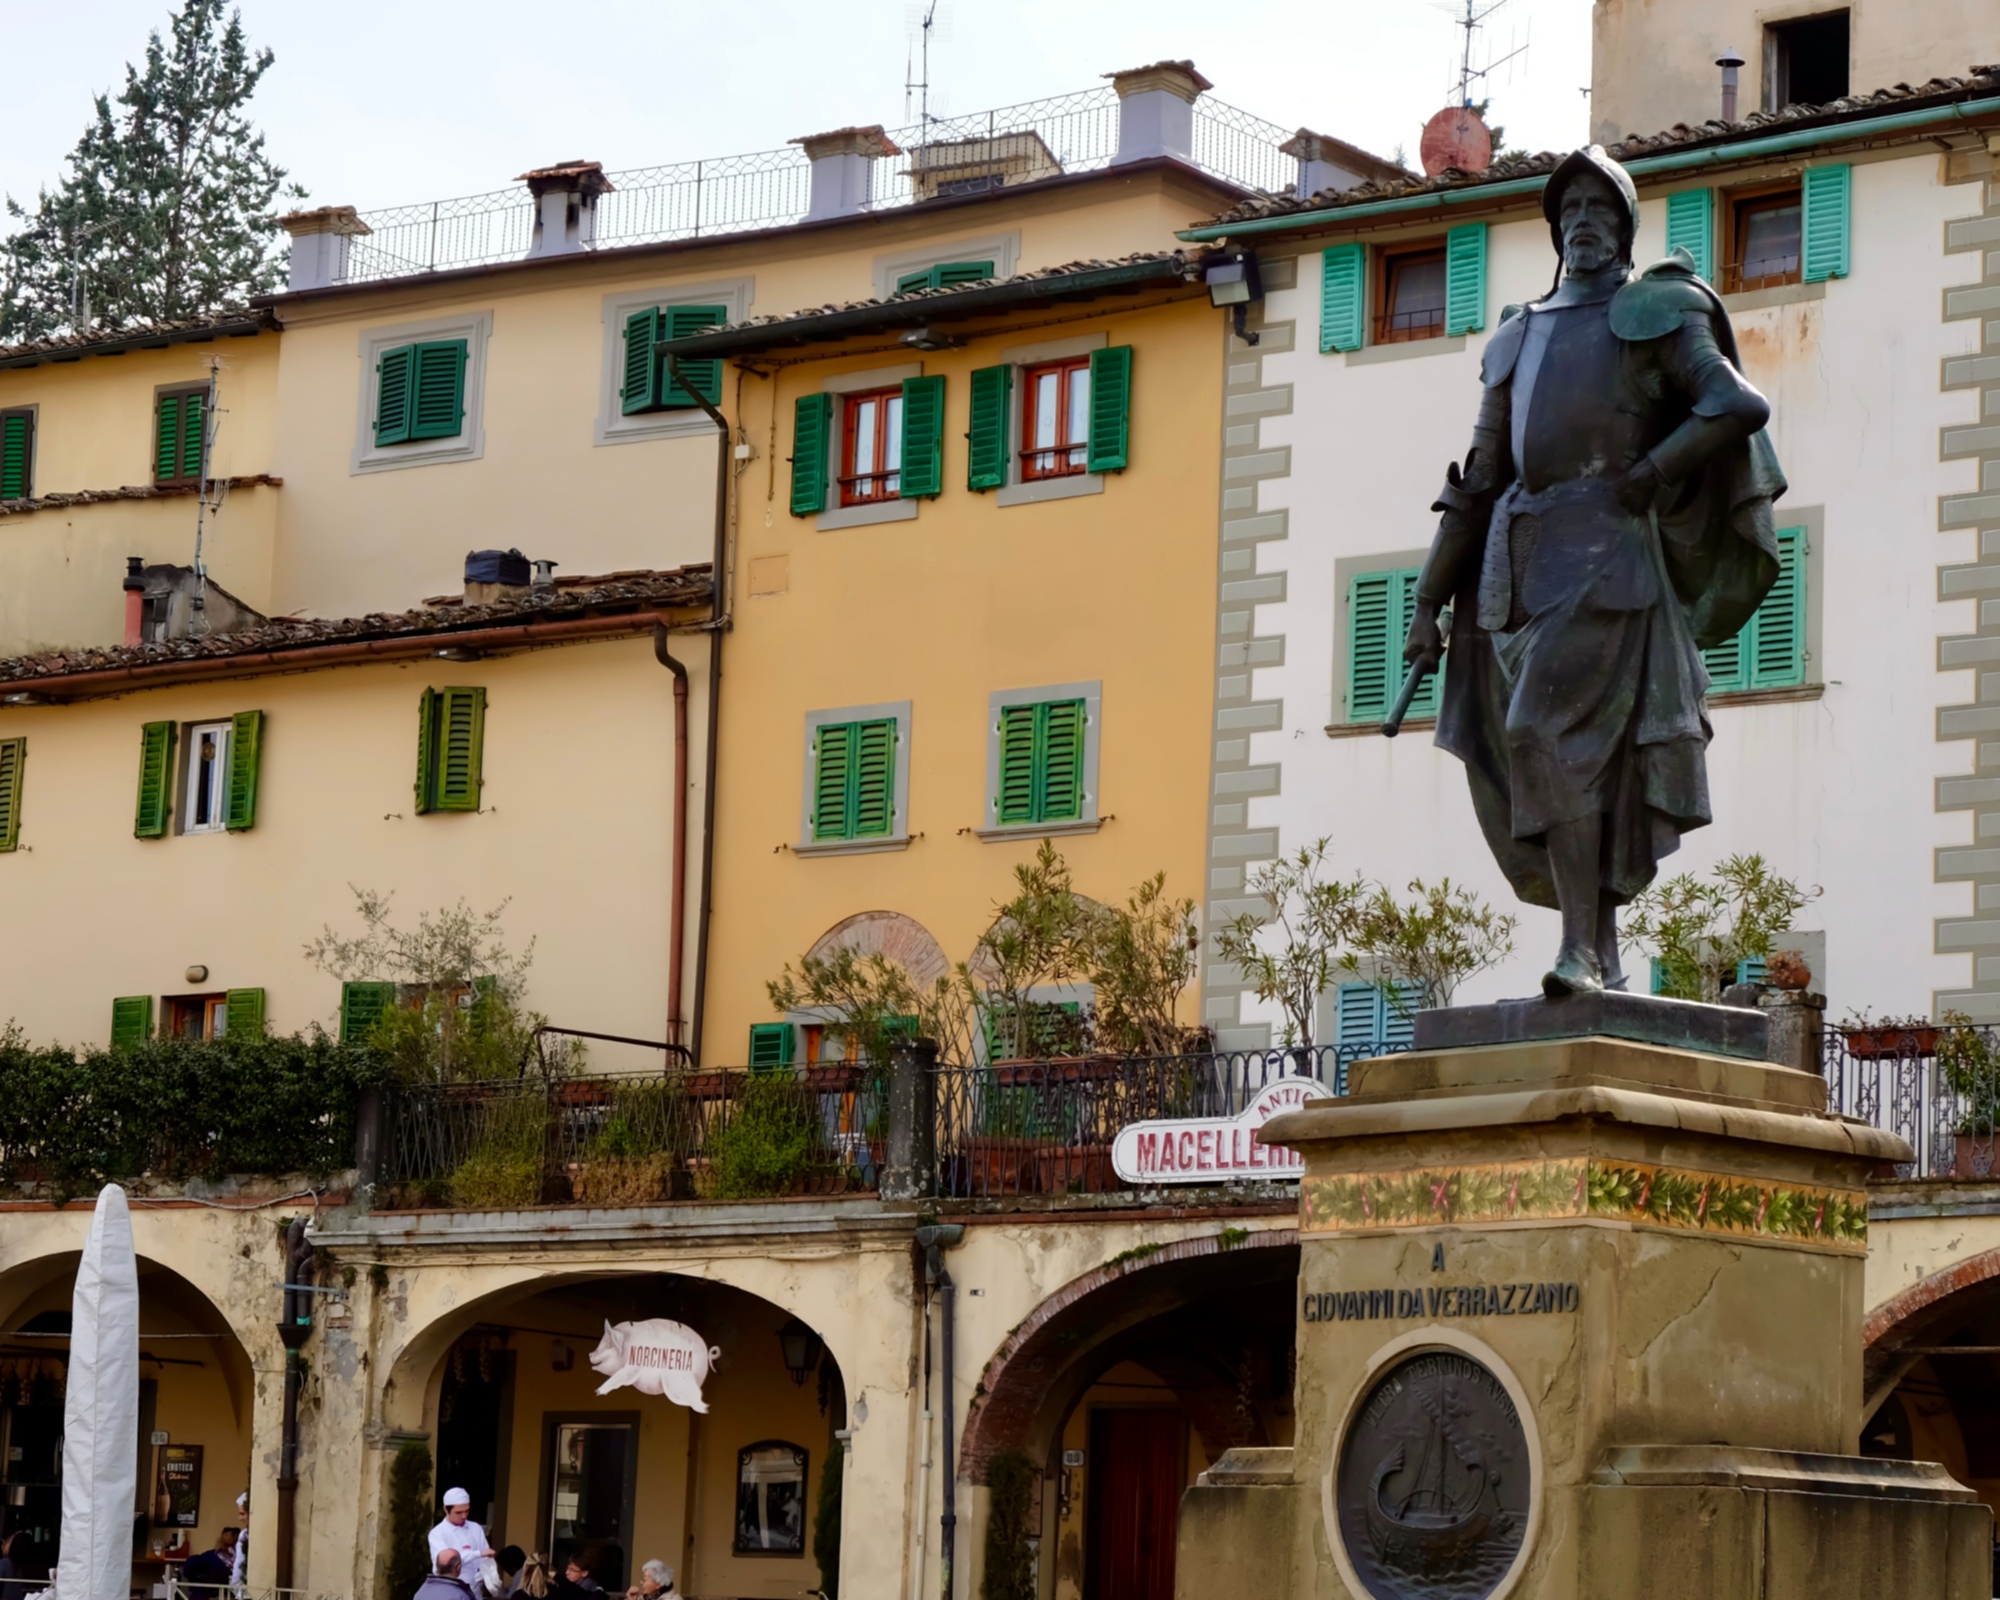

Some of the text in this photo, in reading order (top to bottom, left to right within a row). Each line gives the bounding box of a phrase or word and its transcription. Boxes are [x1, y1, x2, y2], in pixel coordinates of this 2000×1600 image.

[1137, 1127, 1305, 1172] MACELLER
[1431, 1242, 1445, 1272] A
[1302, 1282, 1579, 1322] GIOVANNI DA VERRAZZANO
[629, 1345, 693, 1372] NORCINERIA
[1405, 1356, 1481, 1384] TERMINOS
